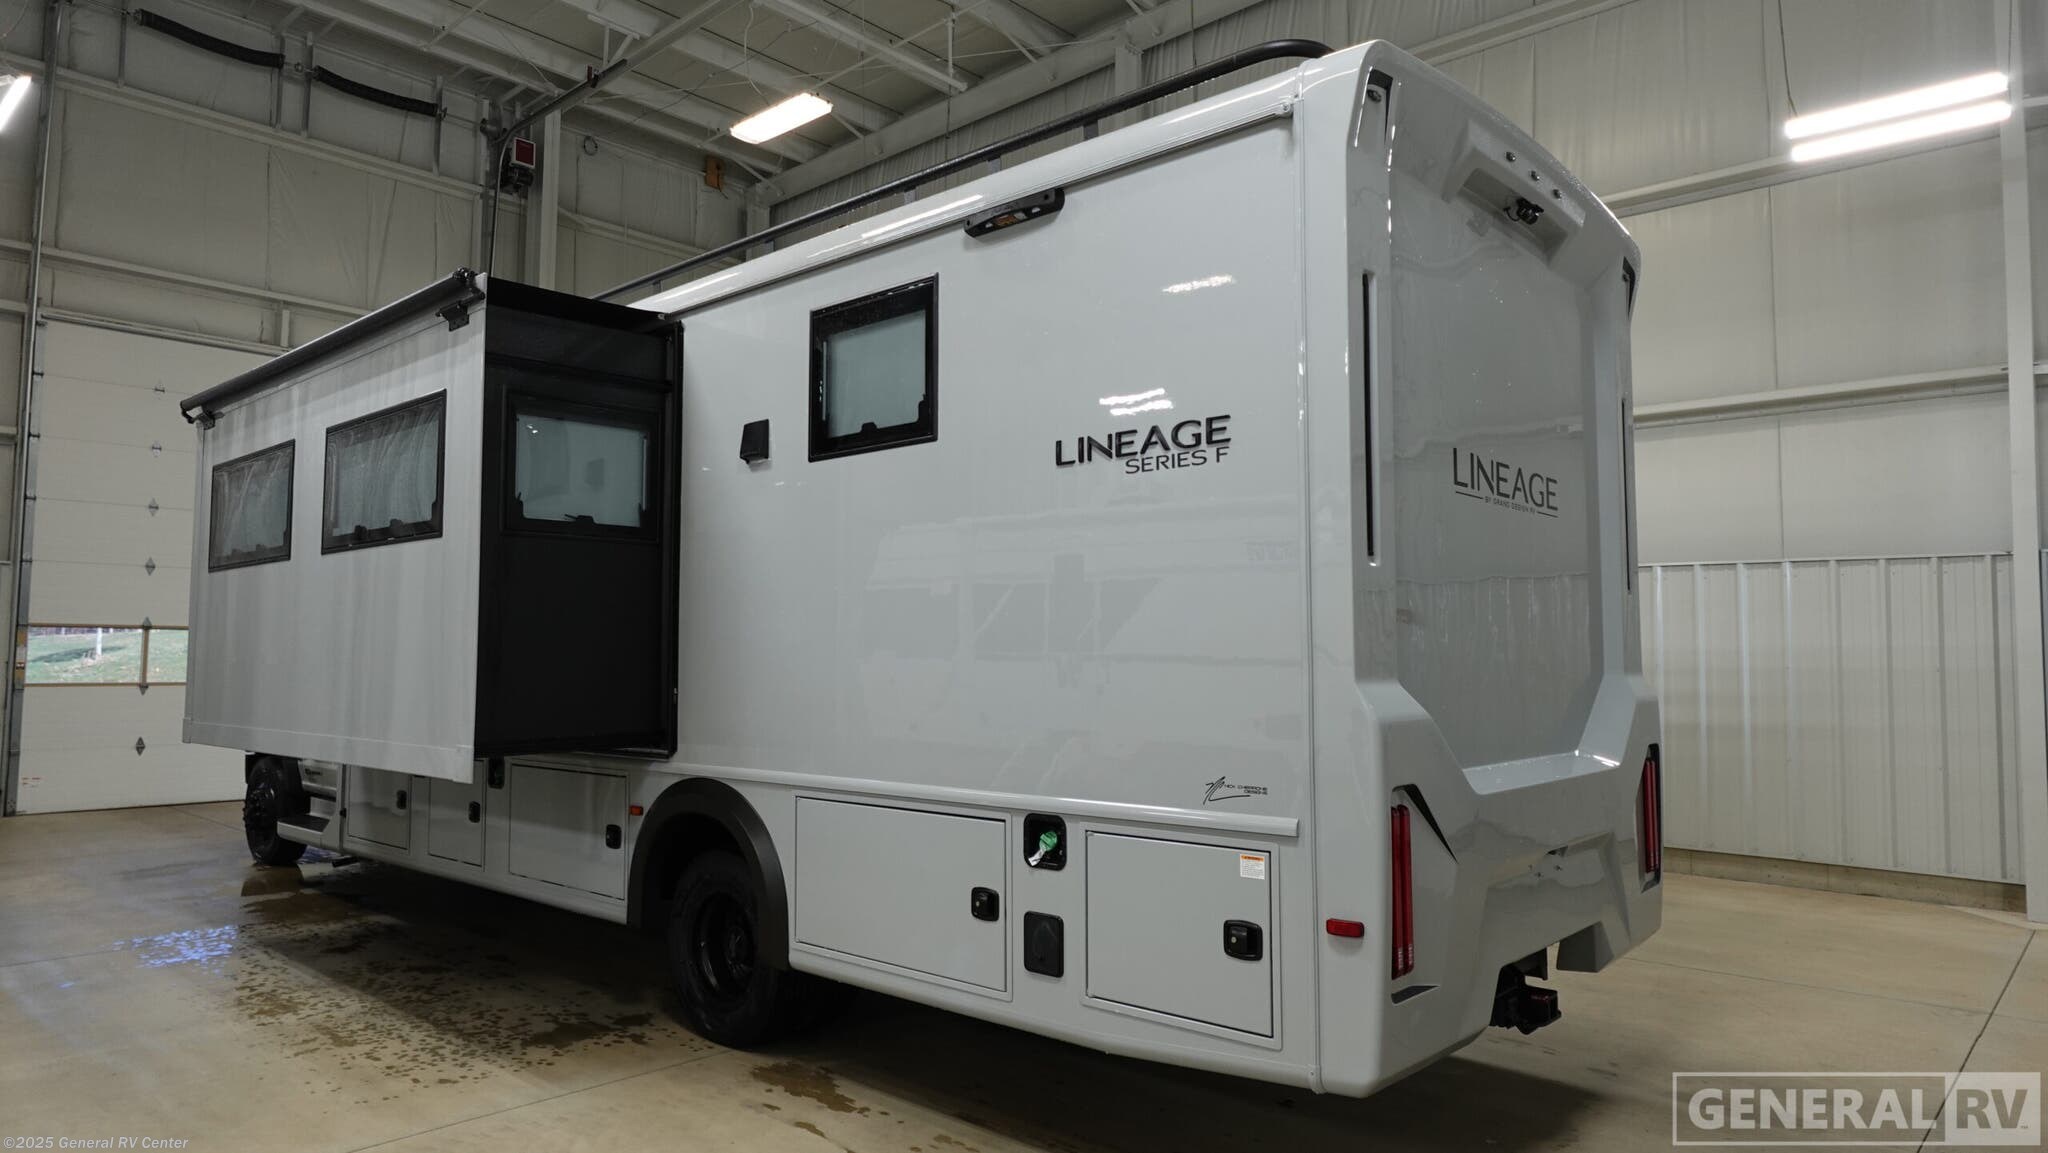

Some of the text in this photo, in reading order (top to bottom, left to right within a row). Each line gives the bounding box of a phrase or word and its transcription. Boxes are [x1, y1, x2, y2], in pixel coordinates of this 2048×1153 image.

[1055, 414, 1231, 467] LINEAGE
[1125, 446, 1230, 474] SERIES F
[1453, 447, 1559, 511] LINEAGE
